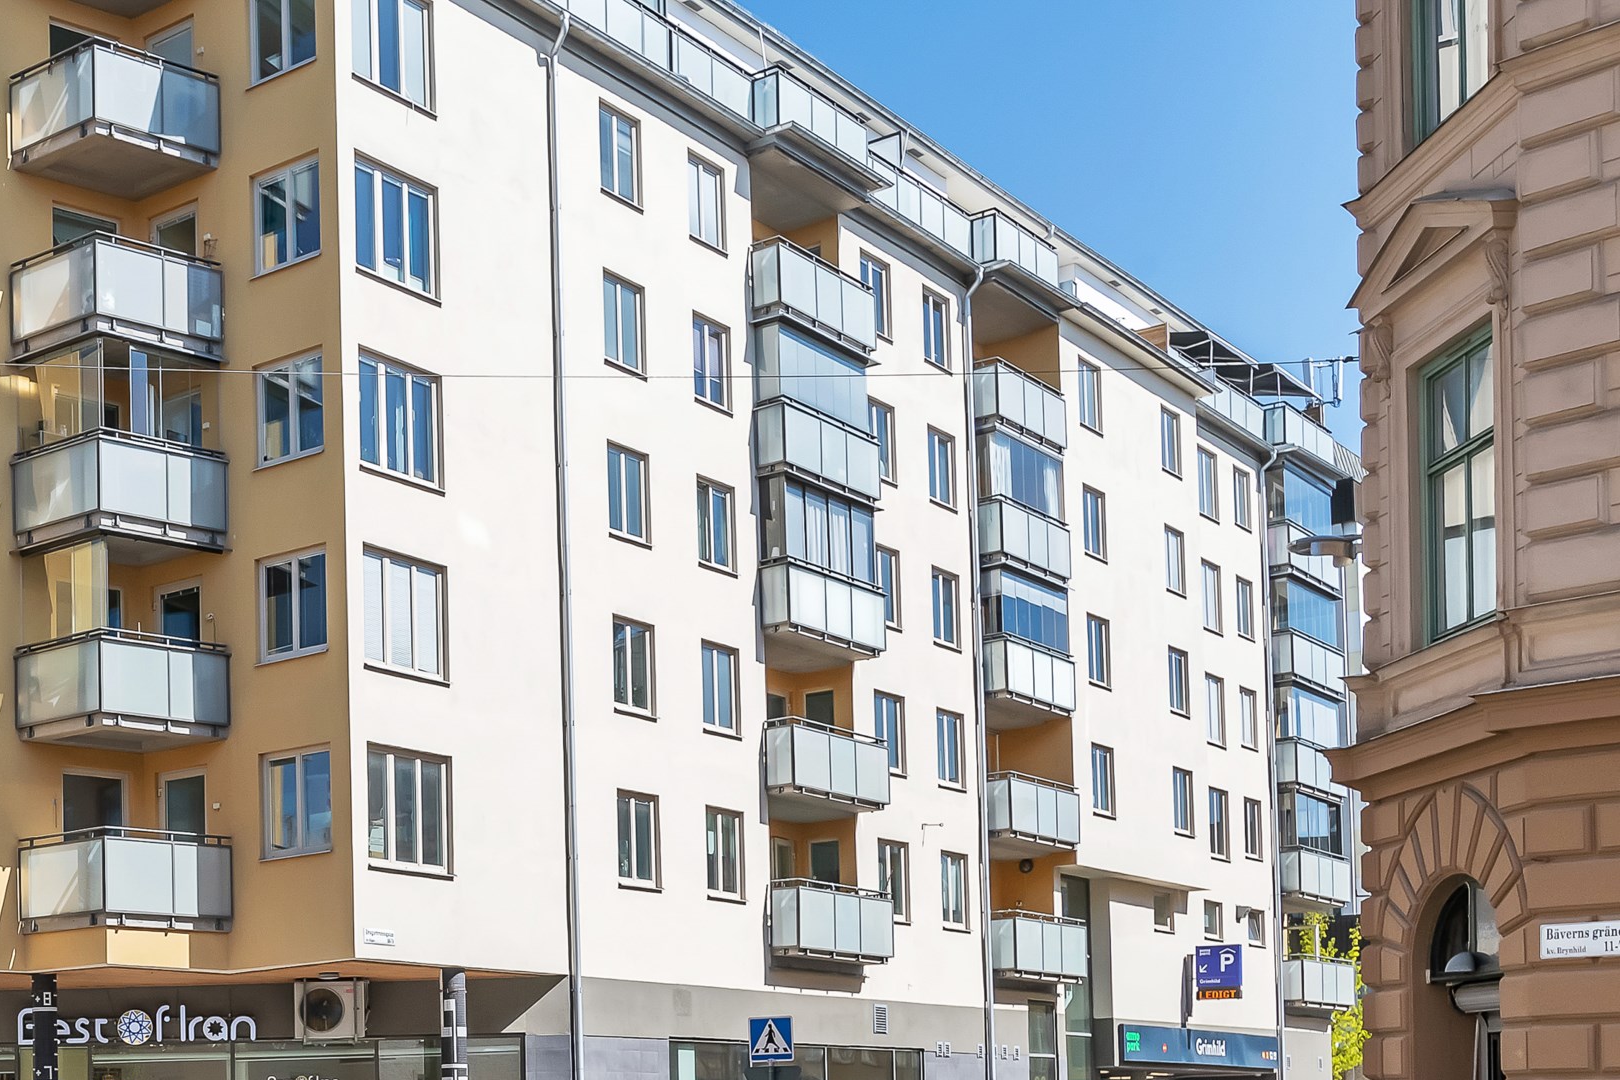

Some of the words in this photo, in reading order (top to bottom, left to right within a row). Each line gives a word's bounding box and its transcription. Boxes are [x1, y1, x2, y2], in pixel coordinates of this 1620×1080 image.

[1546, 928, 1589, 940] Bäverns
[1557, 945, 1586, 955] Brynhild
[1604, 940, 1620, 951] 11-
[1220, 953, 1234, 972] P
[180, 1004, 257, 1042] Iran
[1196, 1038, 1226, 1056] Grimhild
